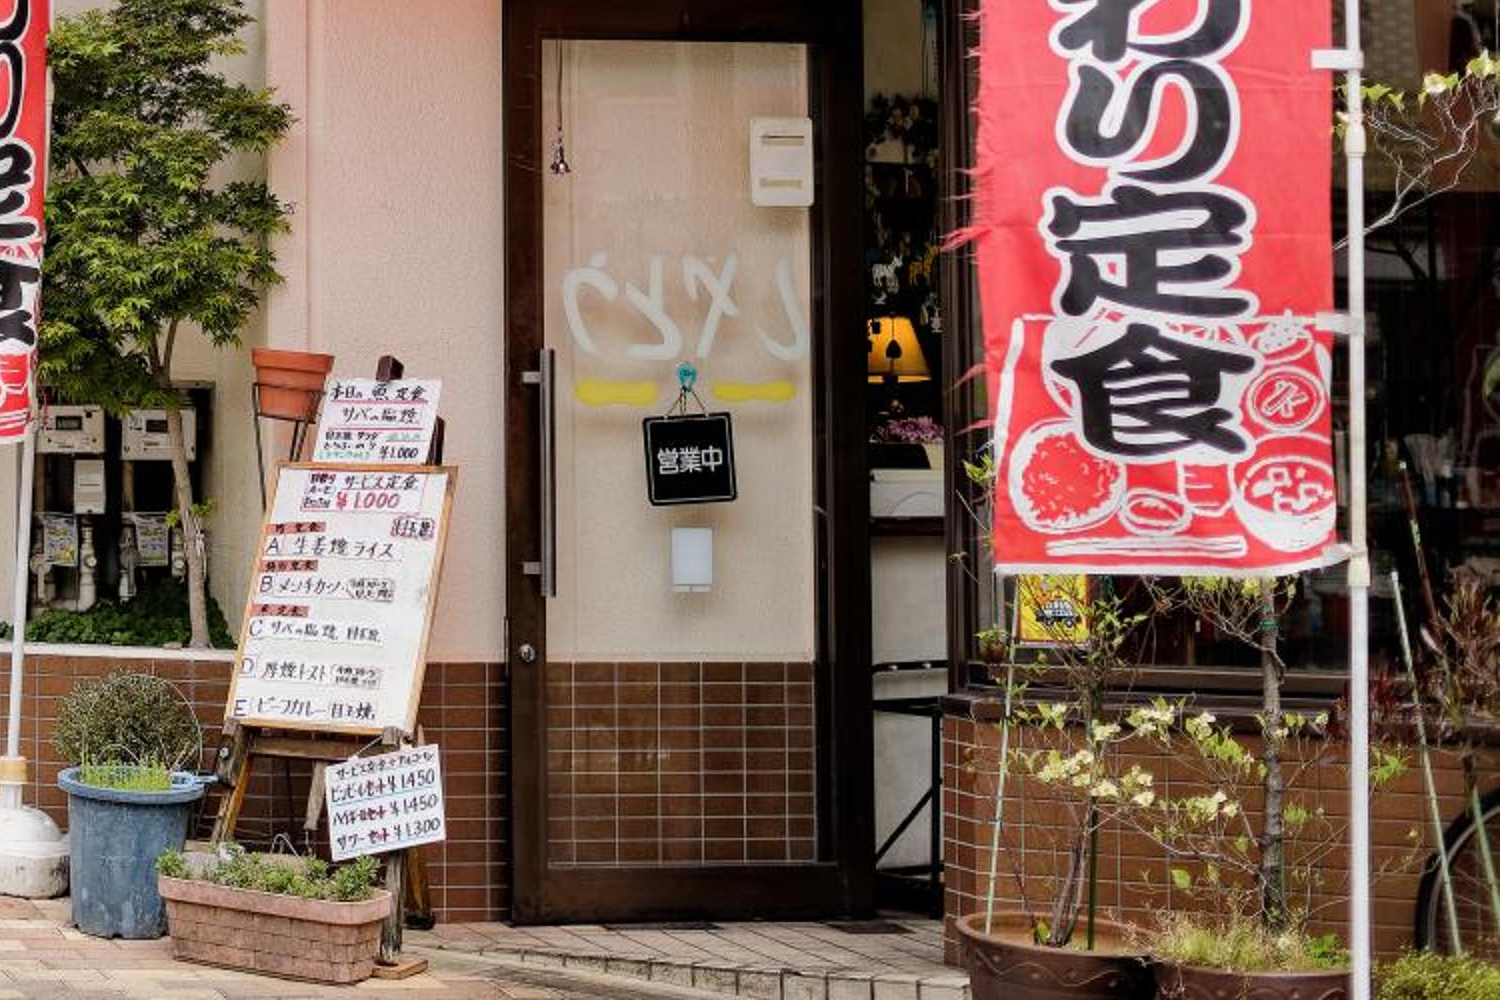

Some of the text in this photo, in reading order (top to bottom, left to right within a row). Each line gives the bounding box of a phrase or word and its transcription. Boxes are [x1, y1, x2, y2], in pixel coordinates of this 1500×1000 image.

[657, 446, 723, 475] 営業中
[266, 538, 279, 553] A
[260, 576, 273, 592] B
[250, 619, 263, 637] C
[234, 699, 247, 717] E
